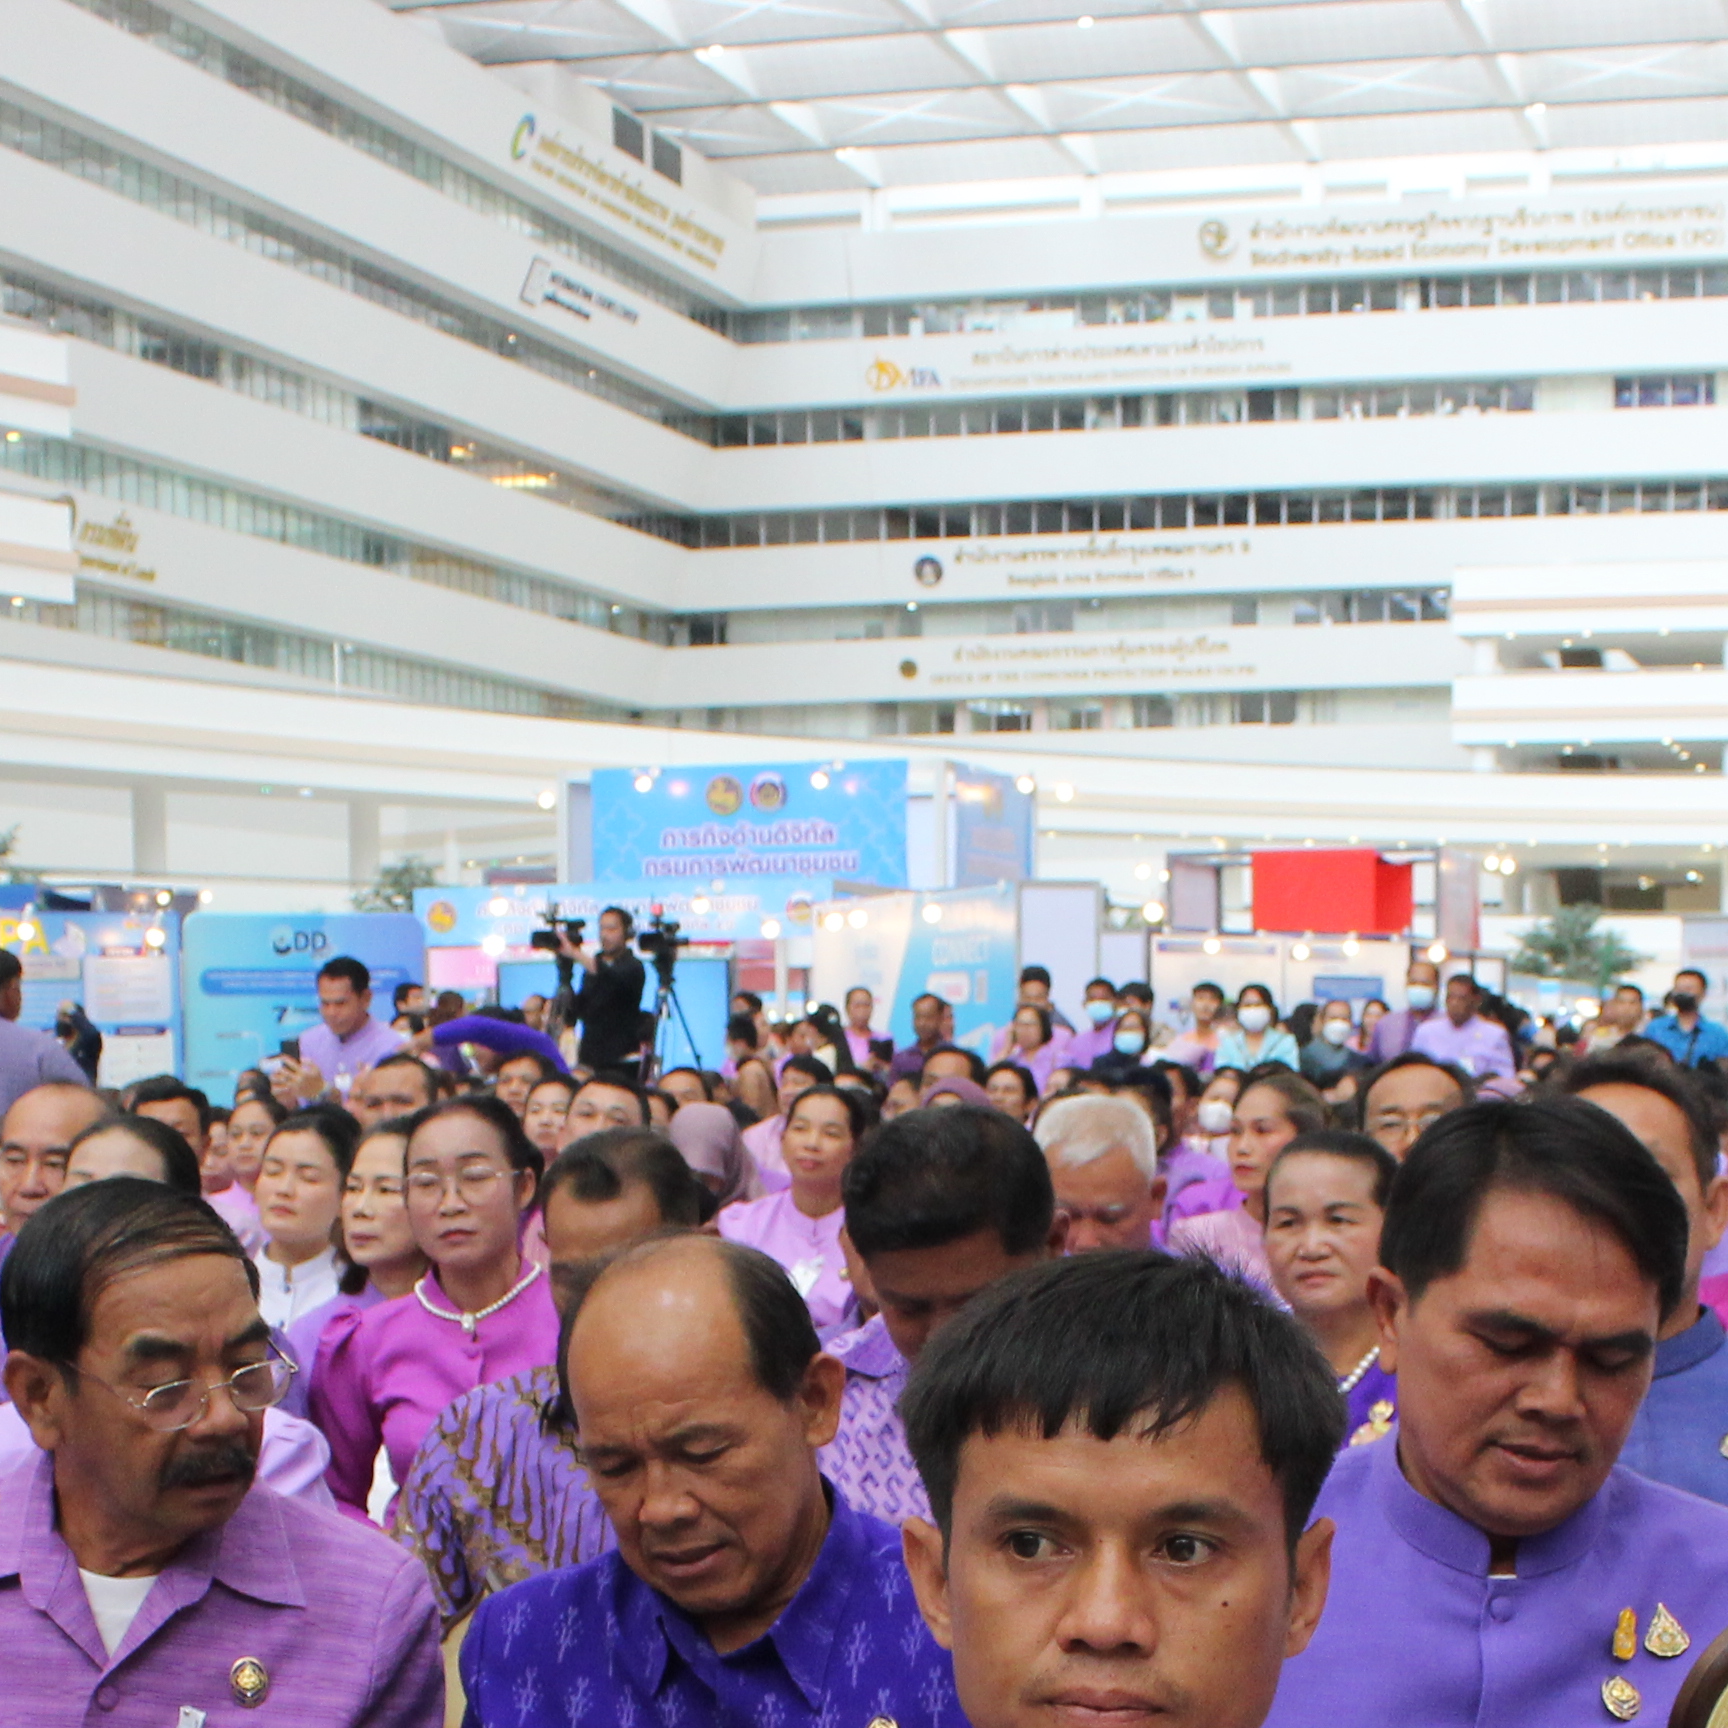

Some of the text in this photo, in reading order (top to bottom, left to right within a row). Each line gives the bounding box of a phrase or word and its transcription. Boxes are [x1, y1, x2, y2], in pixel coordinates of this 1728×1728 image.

[662, 818, 836, 848] ภารกิจด้านดิจิทัล
[644, 849, 858, 877] กรมการพัฒนาชุมชน
